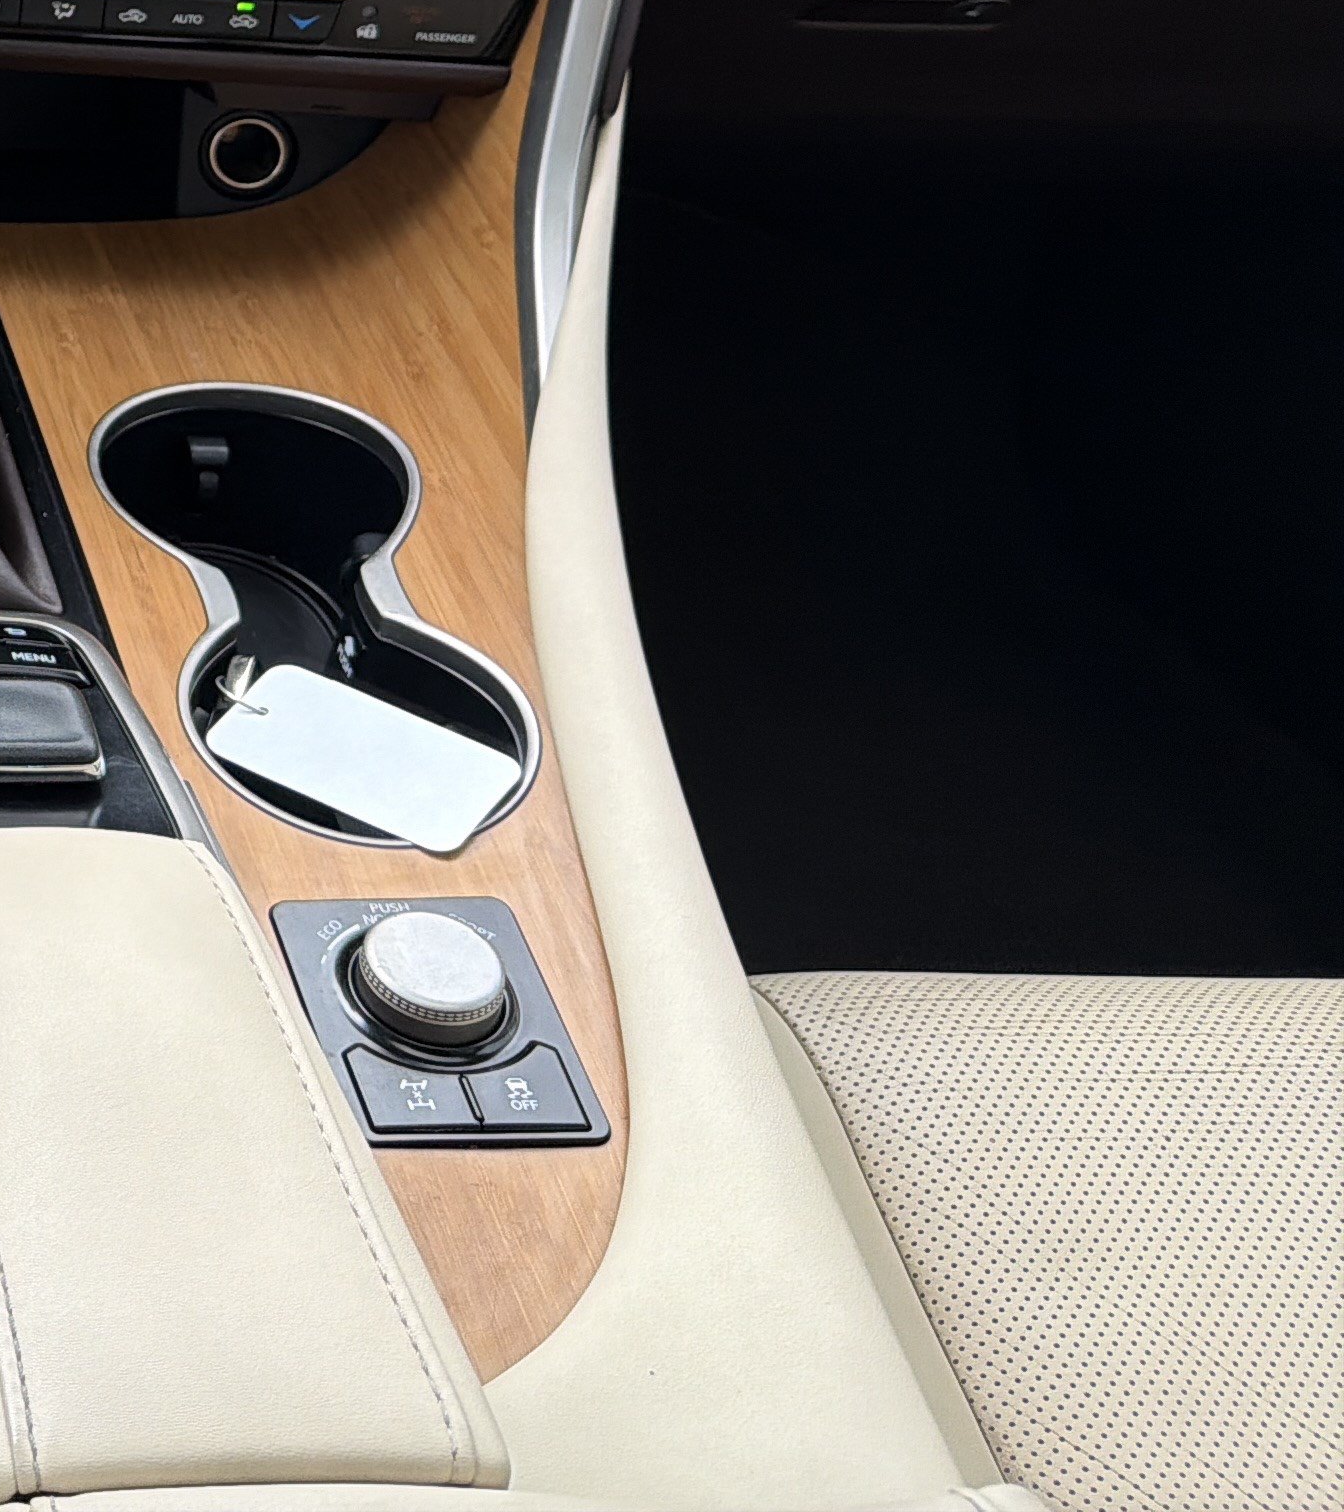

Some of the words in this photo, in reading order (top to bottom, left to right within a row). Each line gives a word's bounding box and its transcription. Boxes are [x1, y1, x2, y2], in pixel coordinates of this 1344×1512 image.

[172, 13, 203, 26] AUTO
[414, 31, 477, 44] PASSENGER
[10, 650, 56, 665] MENU
[368, 901, 411, 914] PUSH
[316, 918, 343, 942] ECO
[510, 1099, 539, 1112] OFF
